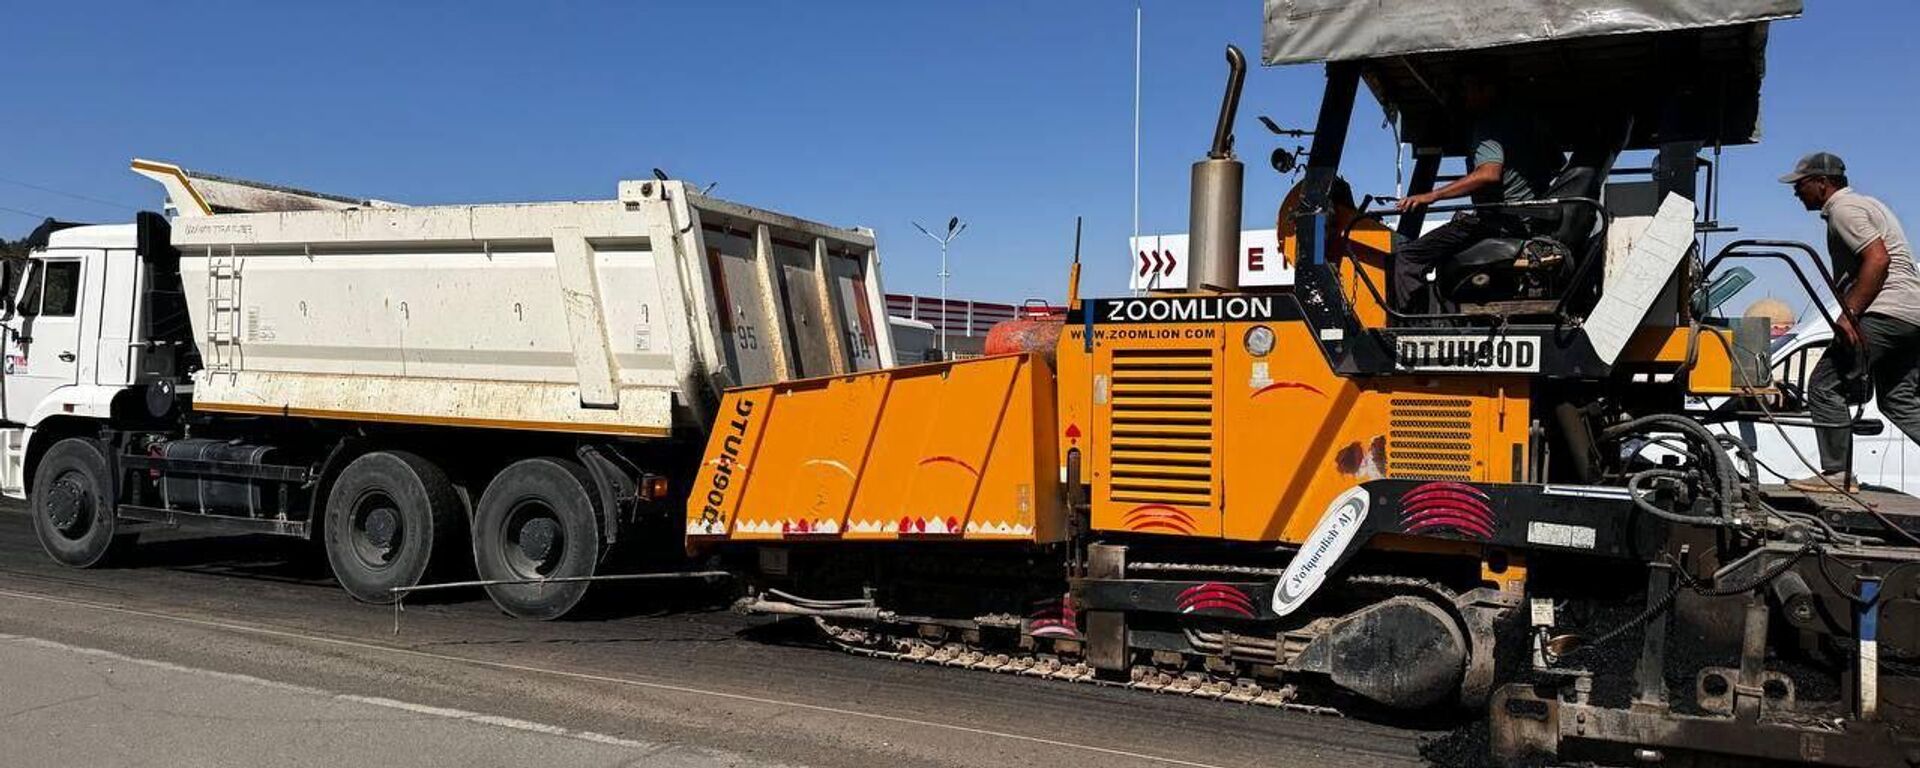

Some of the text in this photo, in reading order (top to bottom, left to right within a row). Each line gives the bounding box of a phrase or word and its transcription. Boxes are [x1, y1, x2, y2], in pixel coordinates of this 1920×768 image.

[1107, 297, 1272, 321] ZOOMLION
[1071, 328, 1215, 340] WW.ZOOMLION COM
[1402, 340, 1534, 367] DTUH90D
